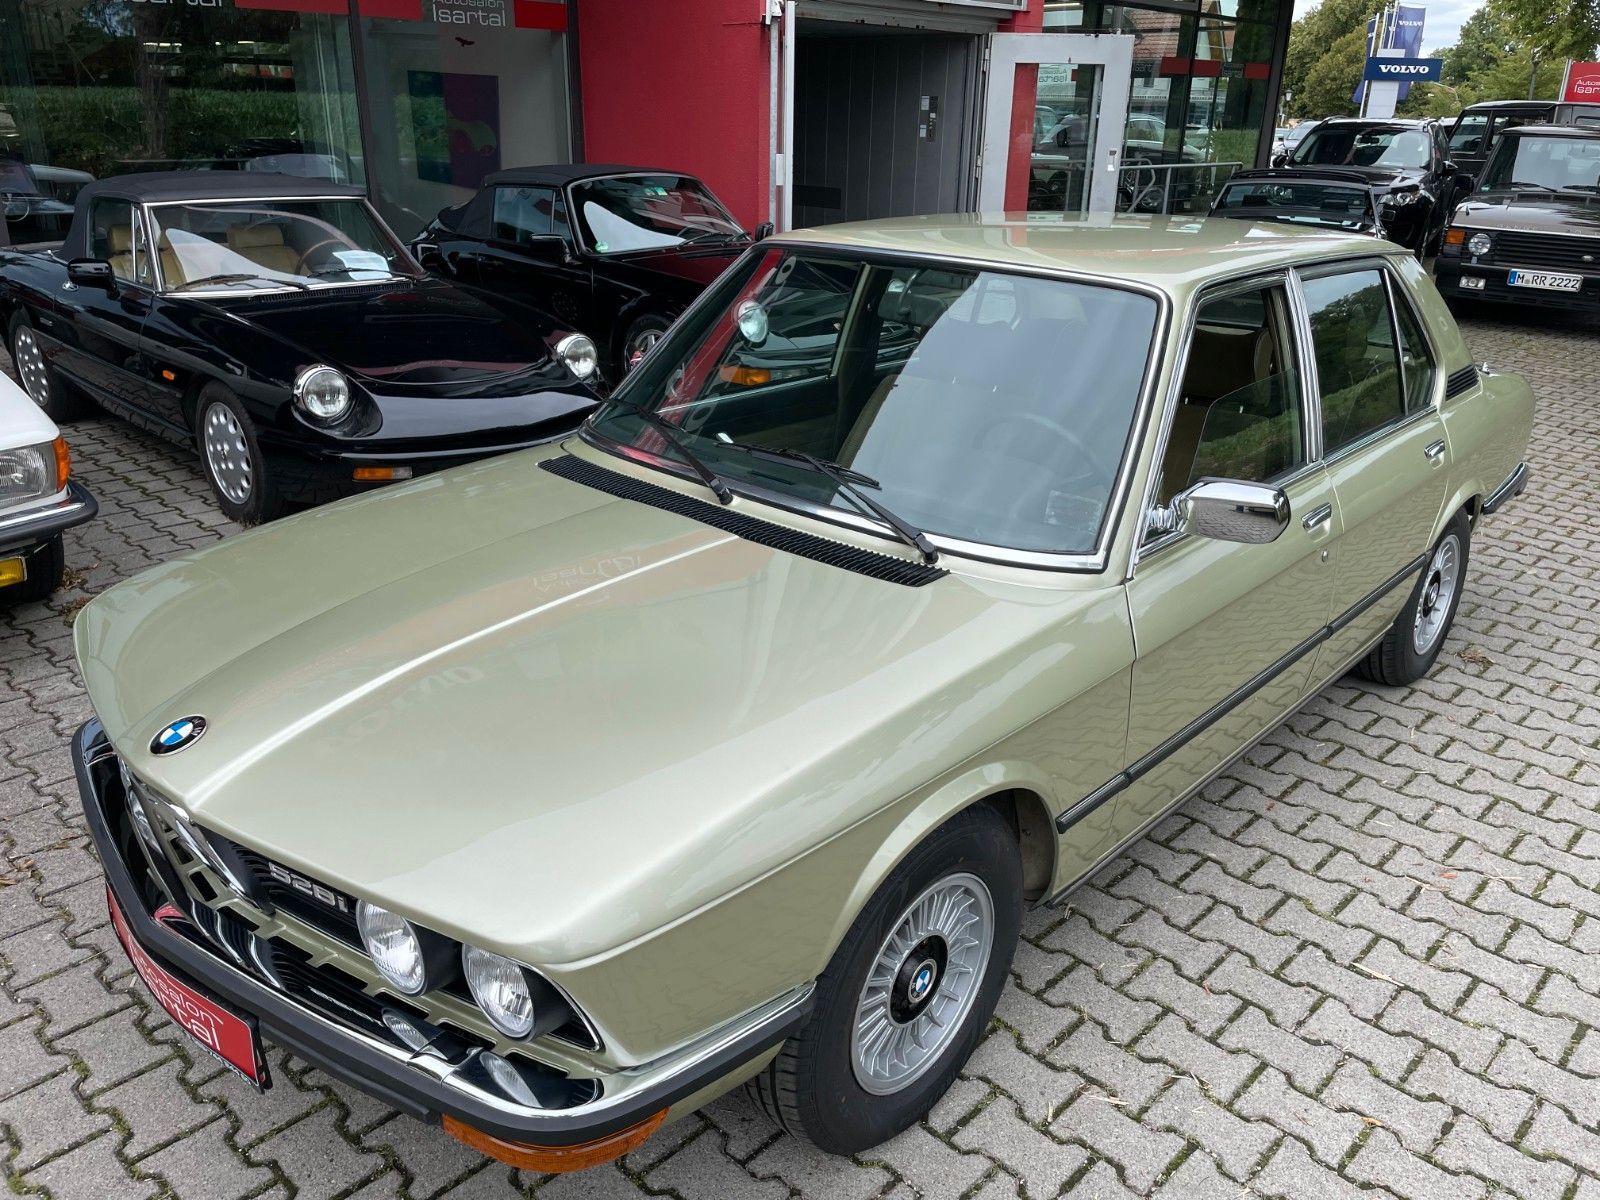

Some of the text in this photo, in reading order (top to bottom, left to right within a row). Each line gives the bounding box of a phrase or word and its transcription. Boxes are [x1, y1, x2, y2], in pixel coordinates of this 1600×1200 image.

[432, 4, 506, 27] Isartal
[1378, 64, 1430, 74] VOLVO
[1516, 273, 1580, 290] M RR 2222
[268, 861, 349, 913] 528i
